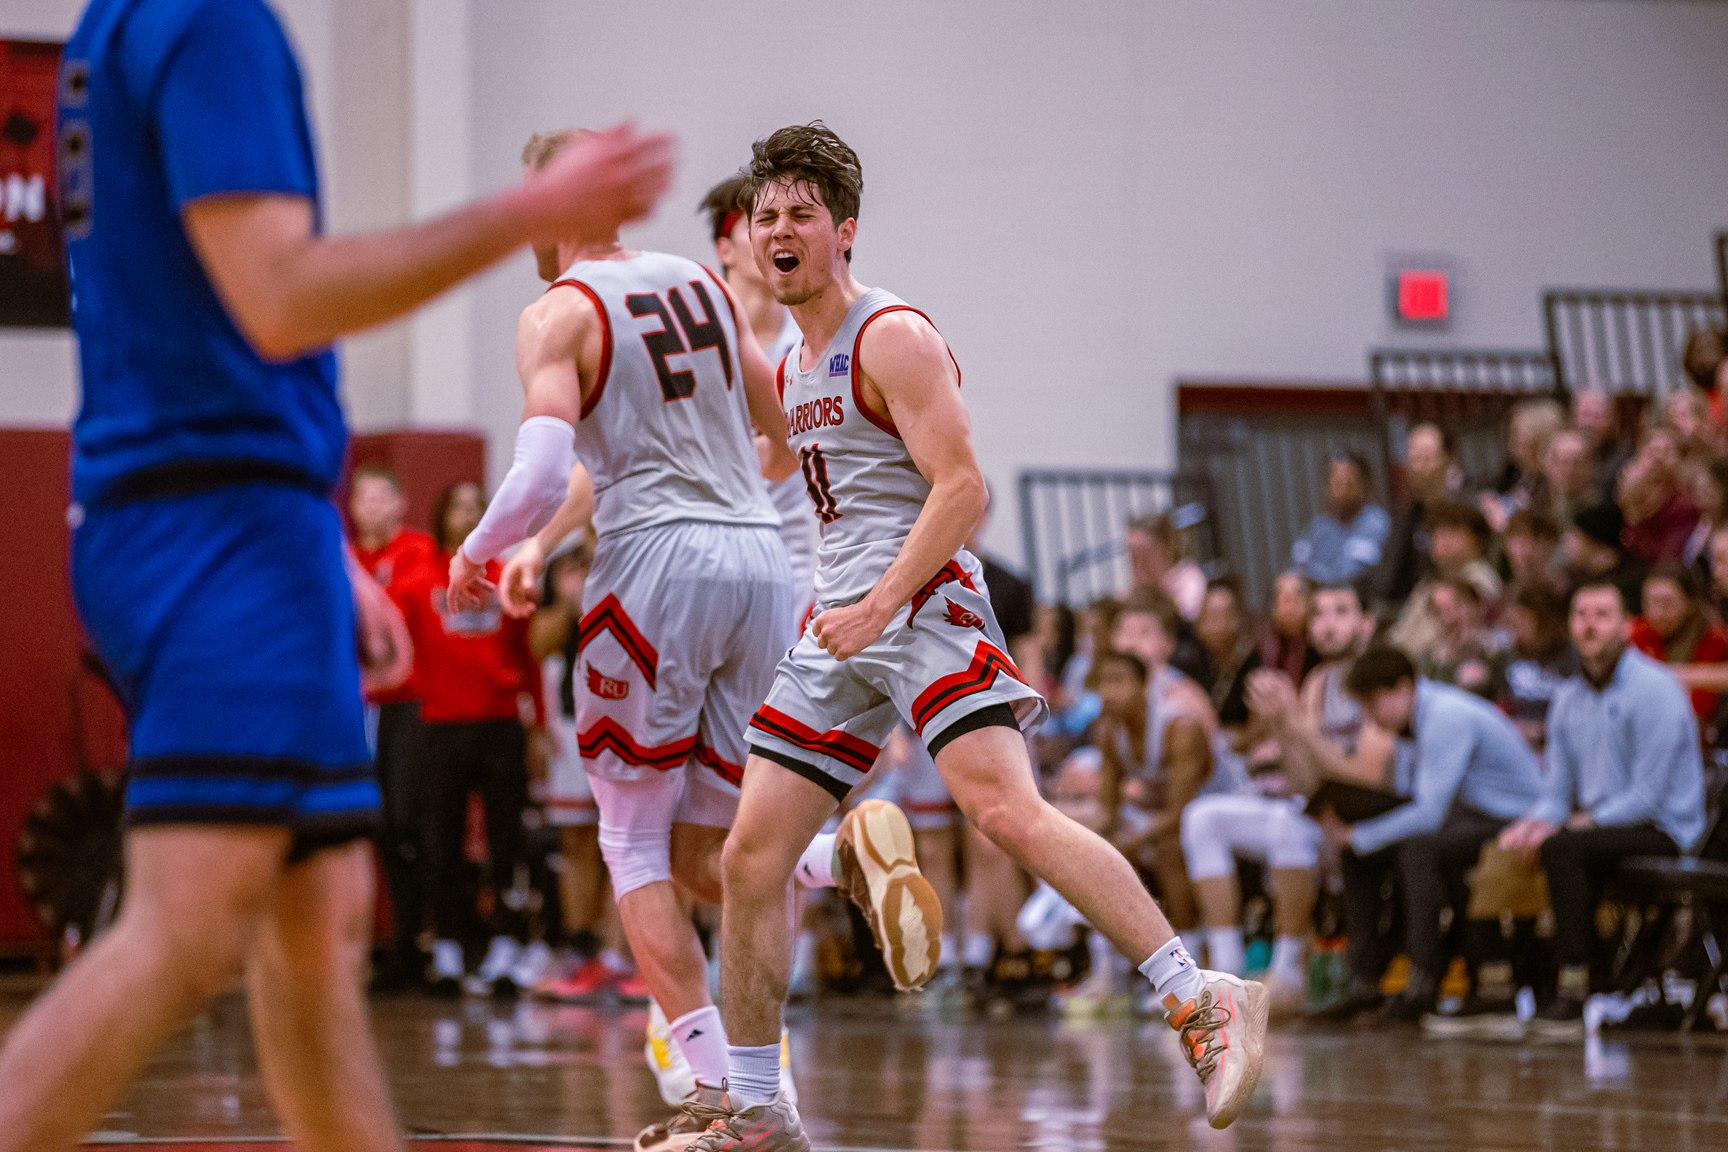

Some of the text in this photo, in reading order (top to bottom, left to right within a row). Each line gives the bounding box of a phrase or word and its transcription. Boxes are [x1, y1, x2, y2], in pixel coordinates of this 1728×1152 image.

[625, 280, 734, 402] 24
[830, 353, 849, 373] WHAC
[785, 396, 844, 439] ARRIORS
[801, 443, 843, 524] 11
[600, 678, 628, 698] RU
